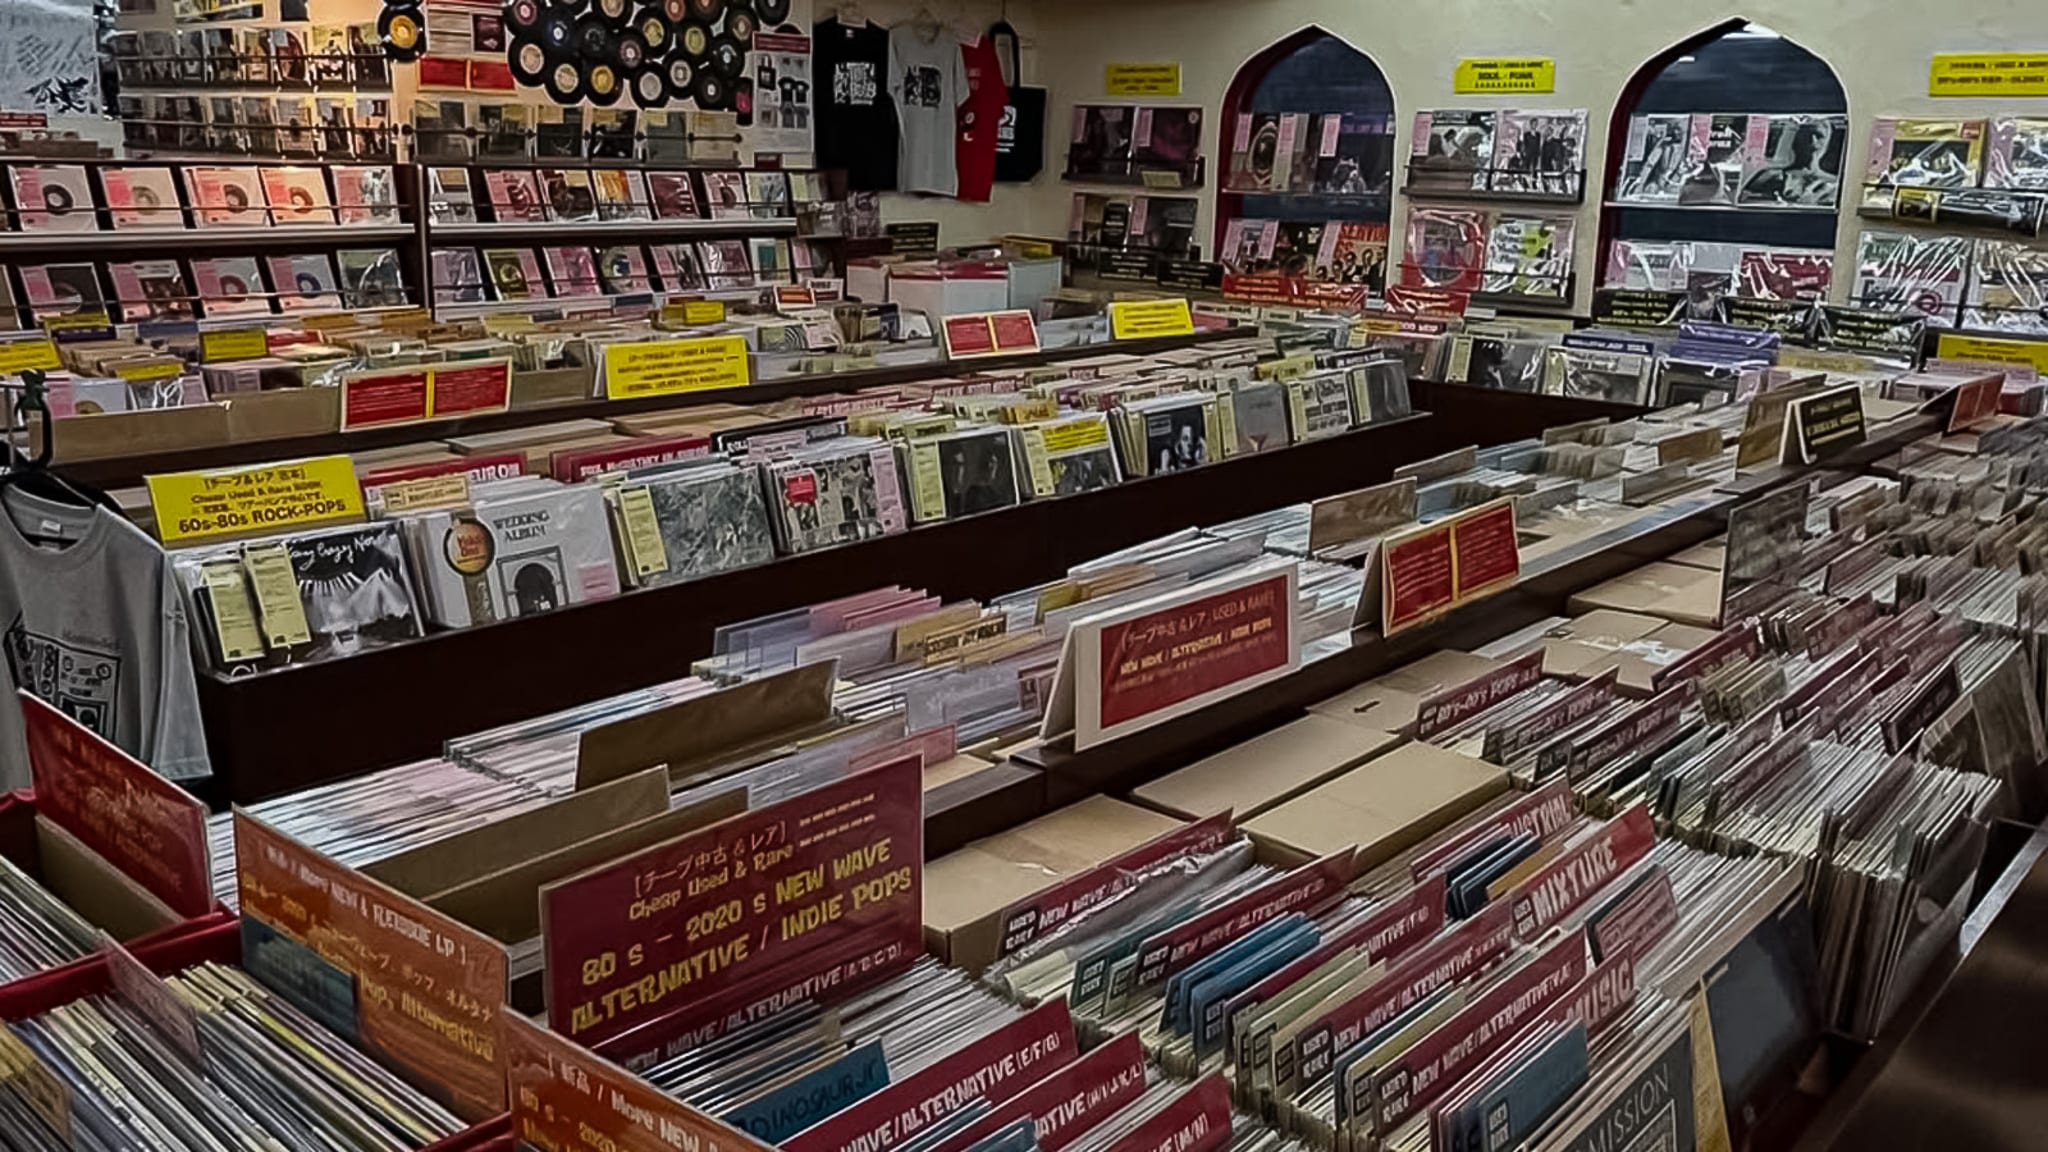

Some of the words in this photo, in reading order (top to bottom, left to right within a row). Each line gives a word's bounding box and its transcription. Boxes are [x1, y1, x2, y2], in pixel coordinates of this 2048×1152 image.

[179, 512, 249, 533] 60s-80s
[252, 500, 346, 525] ROCK-POPS
[504, 525, 547, 542] ALBUM
[629, 890, 681, 921] Cheap
[688, 869, 729, 897] Used
[735, 862, 747, 879] &
[754, 844, 795, 871] Rare
[1531, 836, 1618, 926] MIXTURE
[582, 951, 617, 986] 80
[685, 900, 743, 942] 2020
[775, 863, 824, 905] NEW
[833, 837, 892, 881] WAVE
[1038, 903, 1070, 930] NEW
[436, 932, 455, 958] LP
[571, 933, 750, 1034] ALTERNATIVE
[781, 894, 844, 941] INDIE
[852, 865, 912, 911] POPS
[1334, 1023, 1361, 1052] NEW
[1412, 1059, 1440, 1095] NEW
[659, 1117, 700, 1152] NEW
